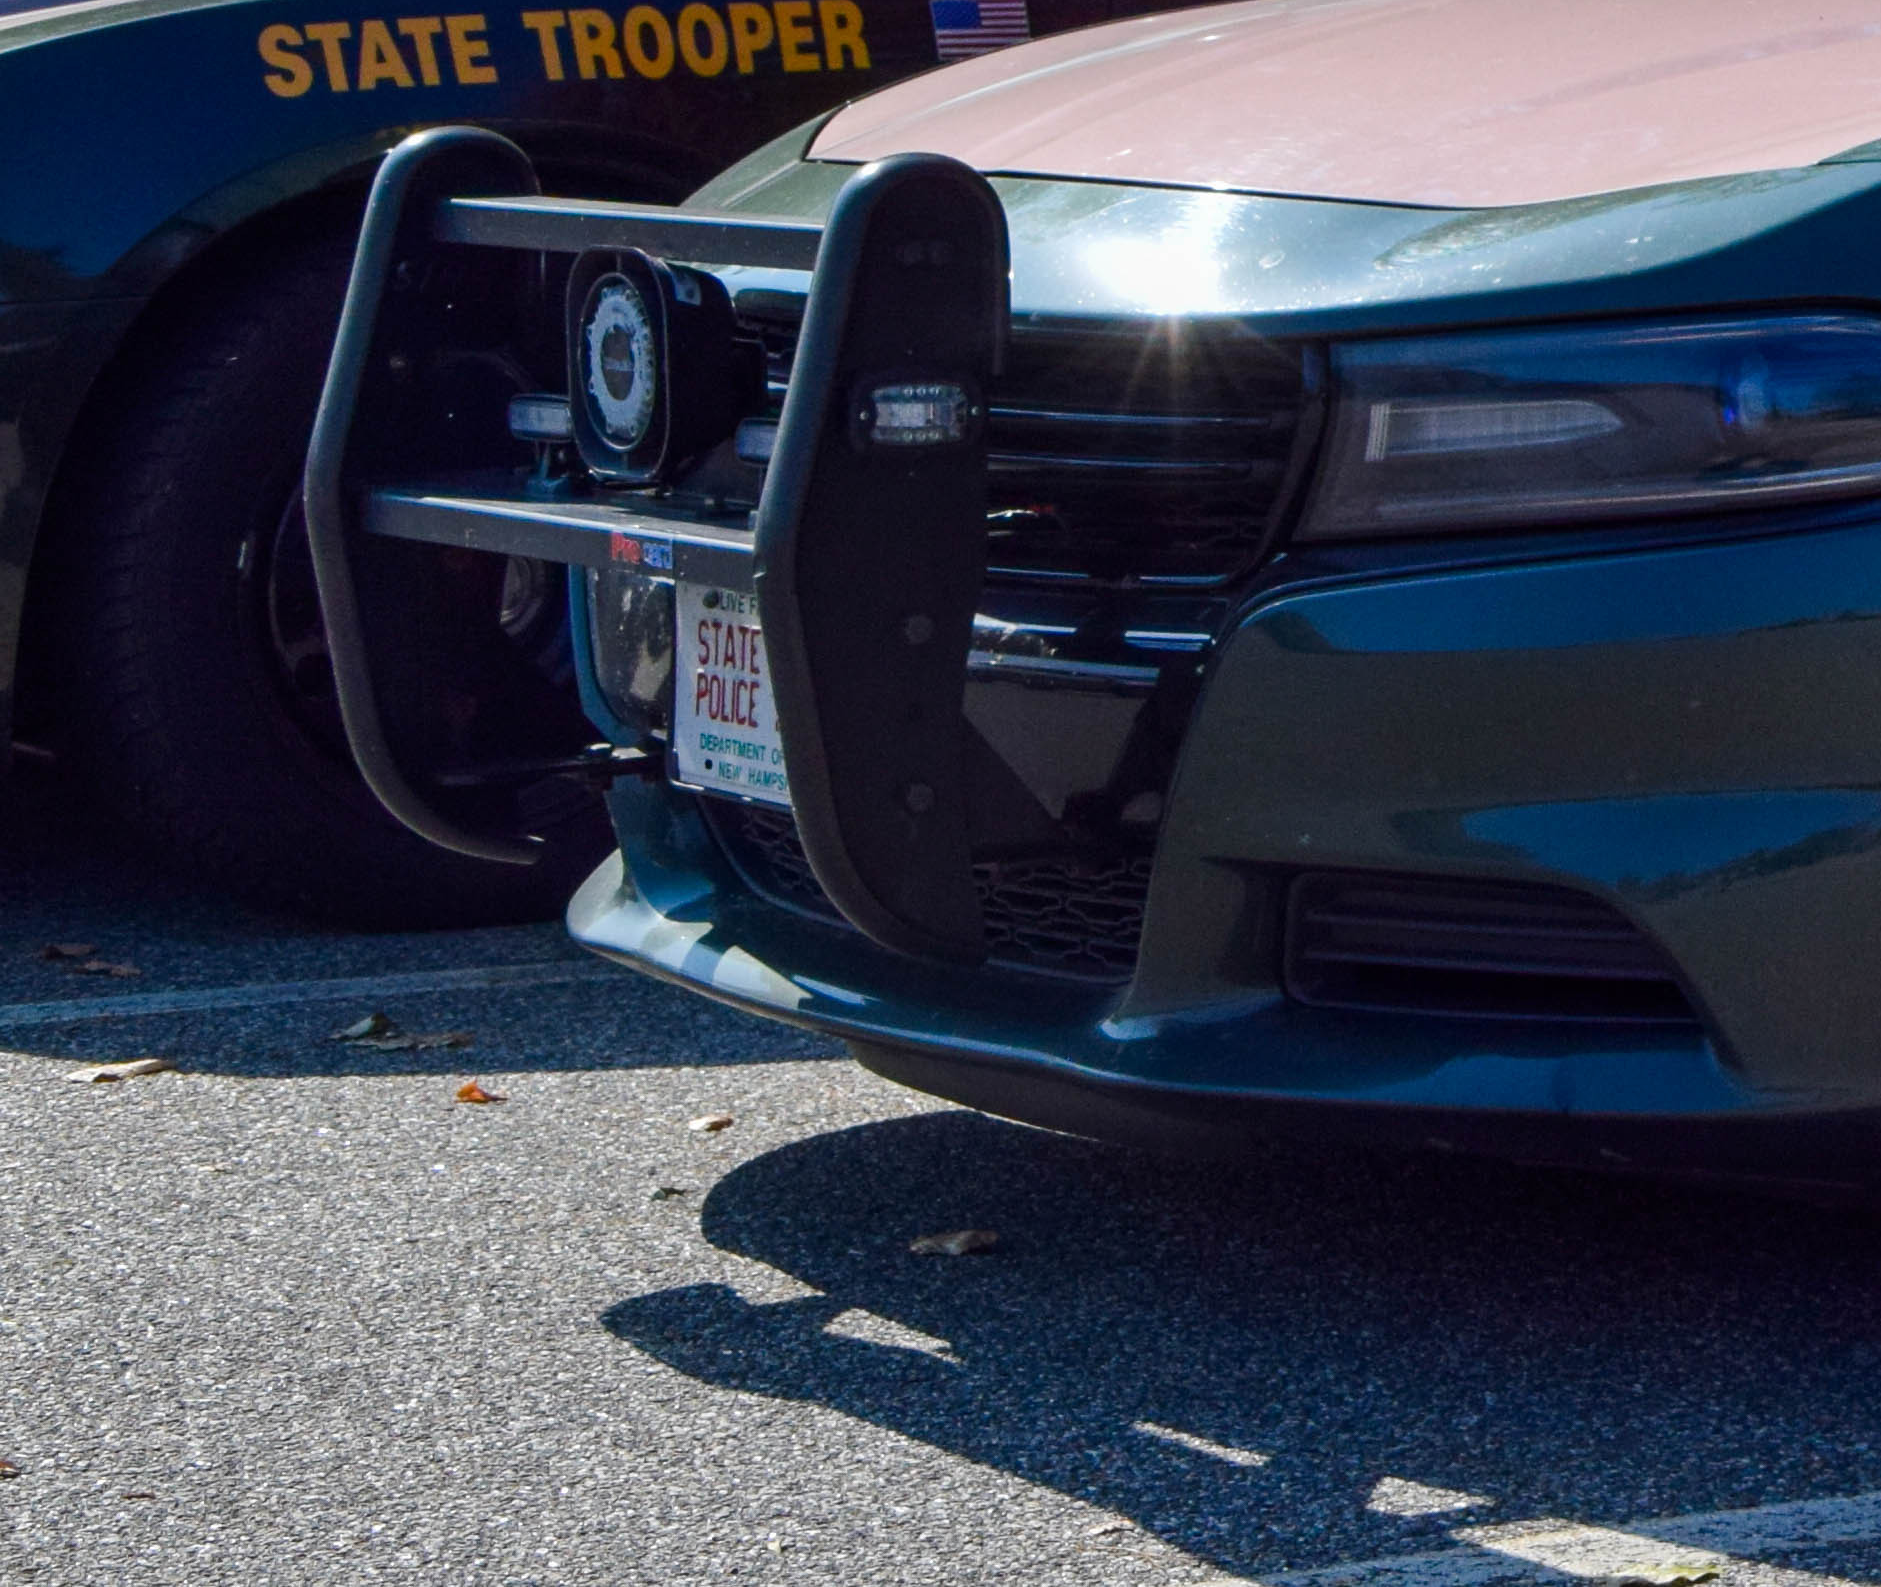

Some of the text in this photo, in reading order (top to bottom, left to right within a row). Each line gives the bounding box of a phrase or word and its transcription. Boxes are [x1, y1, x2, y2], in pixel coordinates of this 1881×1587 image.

[257, 12, 498, 98] STATE
[698, 619, 761, 674] STATE
[695, 673, 760, 728] POLICE
[699, 733, 766, 761] DEPARTMENT
[718, 761, 788, 791] NEW HAMPS
